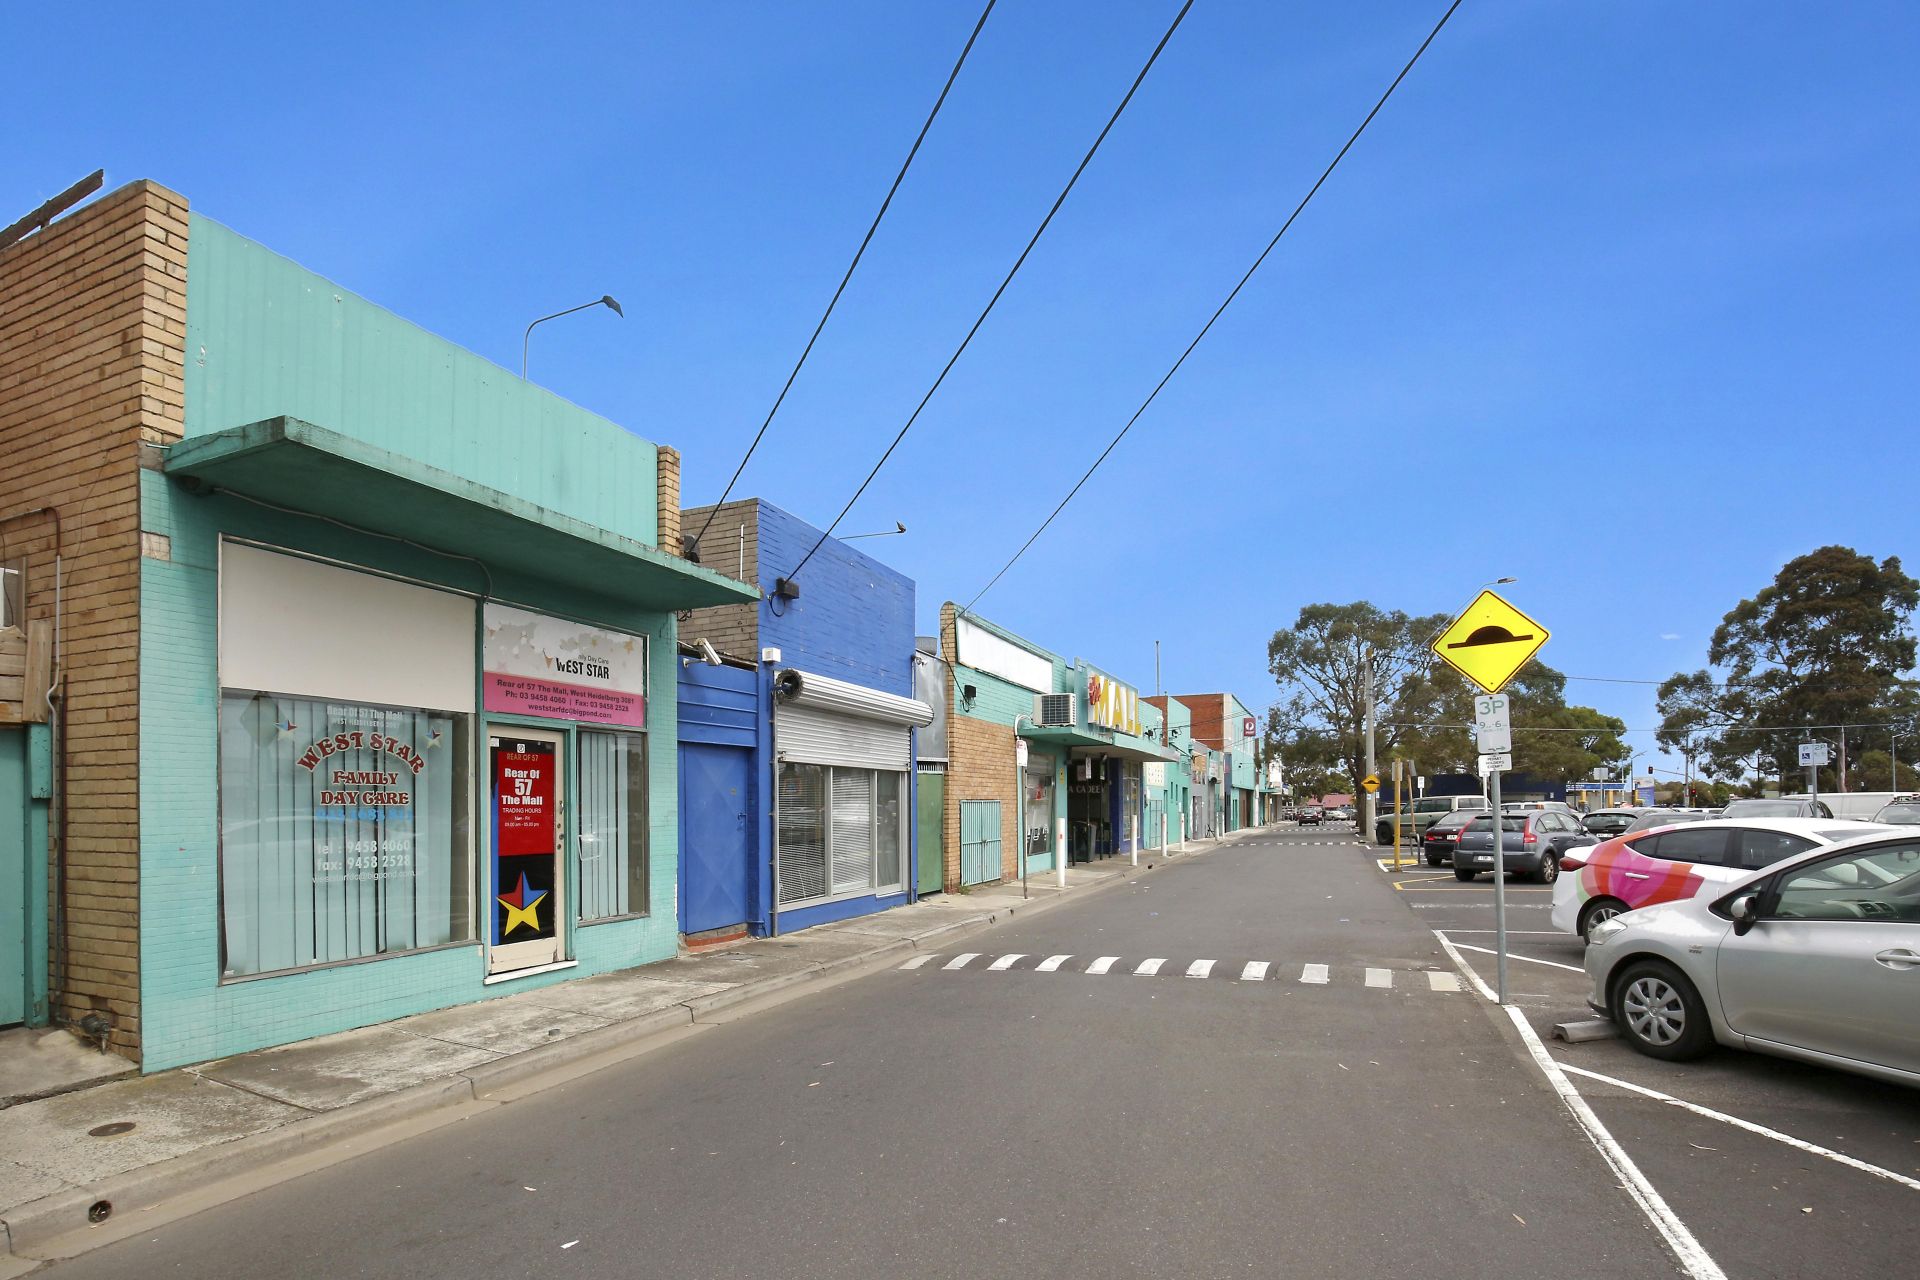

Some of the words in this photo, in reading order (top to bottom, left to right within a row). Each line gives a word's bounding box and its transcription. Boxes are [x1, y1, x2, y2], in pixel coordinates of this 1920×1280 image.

[588, 655, 597, 664] Day
[598, 657, 609, 665] Care
[555, 657, 584, 675] WEST
[586, 663, 609, 680] STAR
[497, 679, 515, 688] Rear
[517, 682, 525, 690] of
[527, 683, 536, 691] 57
[538, 684, 551, 693] The
[570, 689, 586, 698] West
[587, 692, 620, 704] Heidelberg
[505, 690, 518, 699] Ph:
[519, 691, 529, 700] 03
[530, 693, 548, 702] 9458
[575, 699, 589, 708] Fax:
[1092, 674, 1142, 736] MALL
[1479, 700, 1505, 716] 3P
[359, 707, 369, 718] 57
[369, 708, 385, 719] The
[385, 710, 403, 721] Mall
[297, 731, 364, 772] WEST
[369, 732, 426, 775] STAR
[506, 752, 522, 761] REAR
[531, 754, 539, 762] 57
[333, 770, 398, 785] FAMILY
[504, 768, 529, 779] Rear
[530, 769, 540, 779] Of
[514, 778, 533, 796] 57
[320, 790, 359, 805] DAY
[361, 791, 410, 806] CARE
[501, 795, 521, 805] The
[522, 795, 543, 805] Mall
[347, 840, 378, 853] 9458
[382, 839, 411, 852] 4060
[347, 856, 378, 869] 9458
[382, 854, 411, 868] 2528
